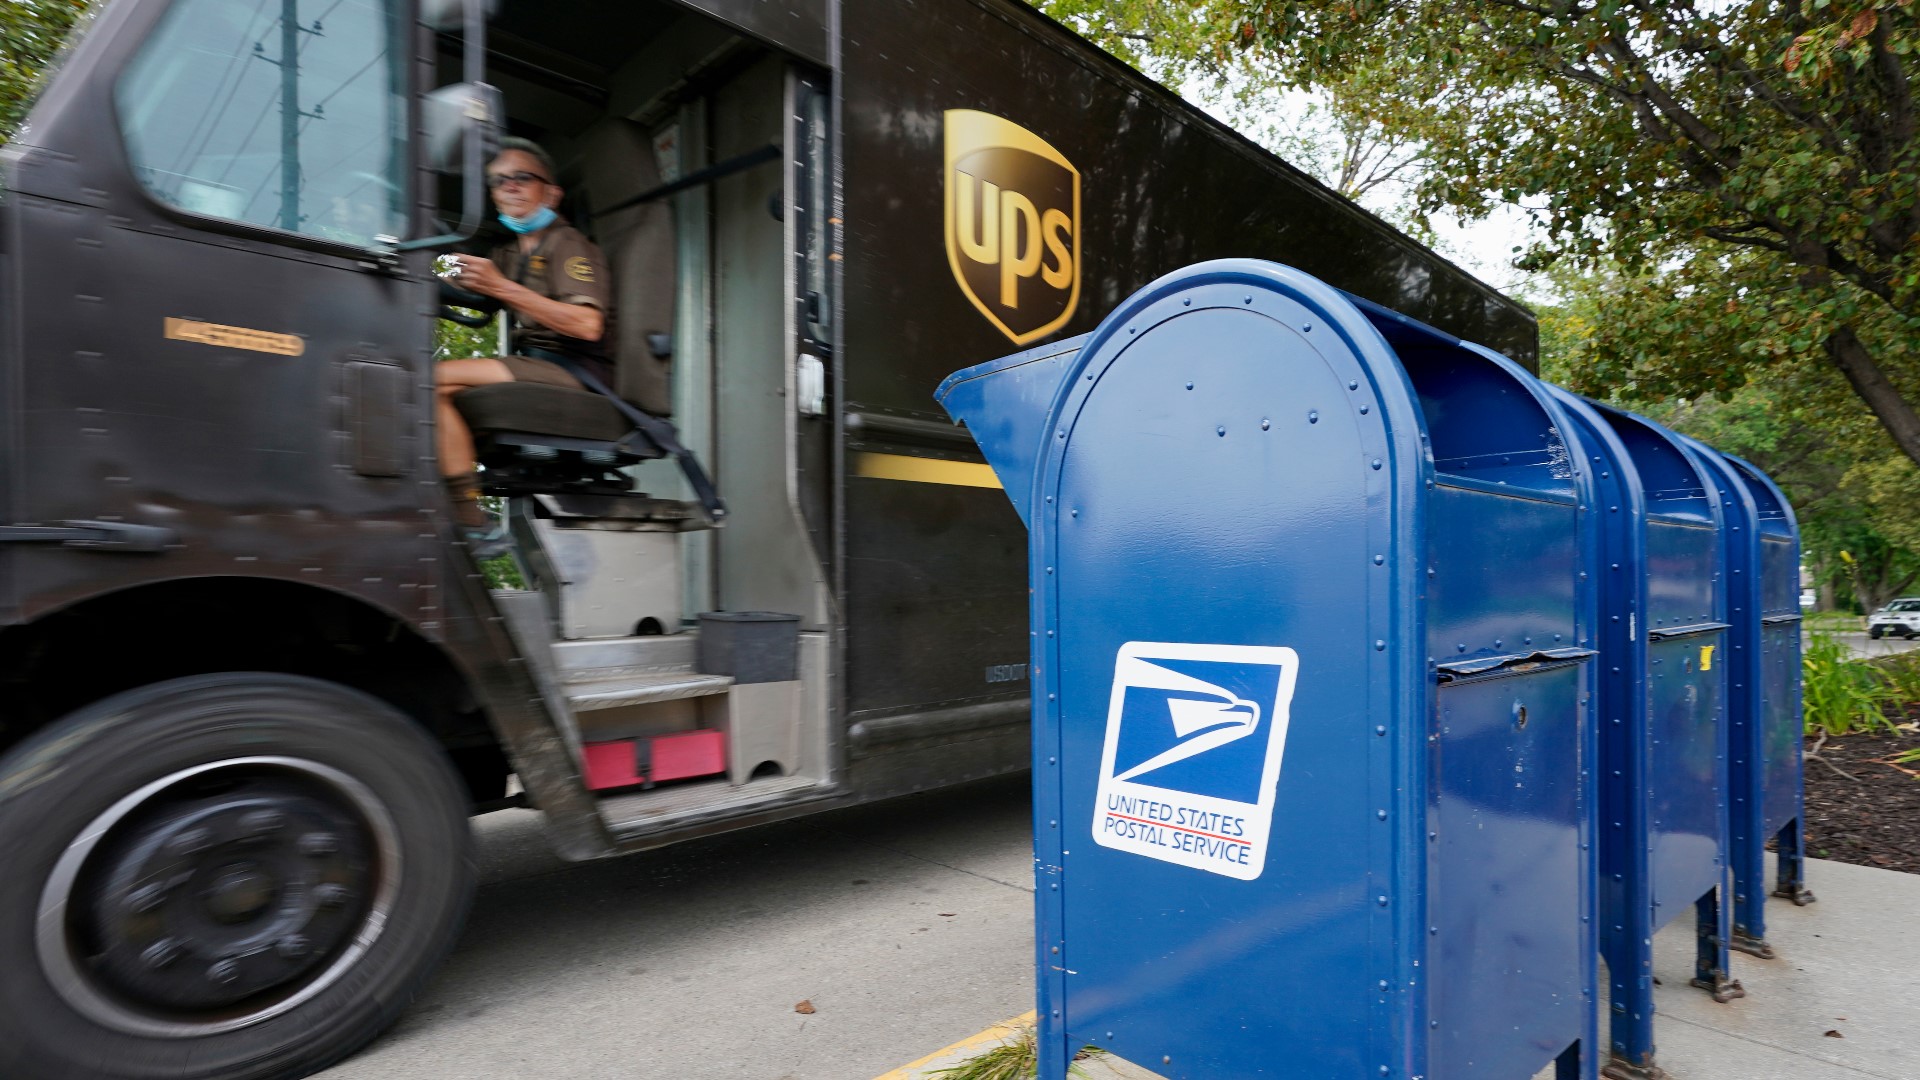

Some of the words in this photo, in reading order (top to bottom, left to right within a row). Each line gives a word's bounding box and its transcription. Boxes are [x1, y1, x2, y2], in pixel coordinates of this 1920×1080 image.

[956, 168, 1073, 309] ups
[1107, 793, 1173, 822] UNITED
[1176, 807, 1245, 837] STATES
[1104, 816, 1167, 847] POSTAL
[1172, 831, 1251, 866] SERVICE
